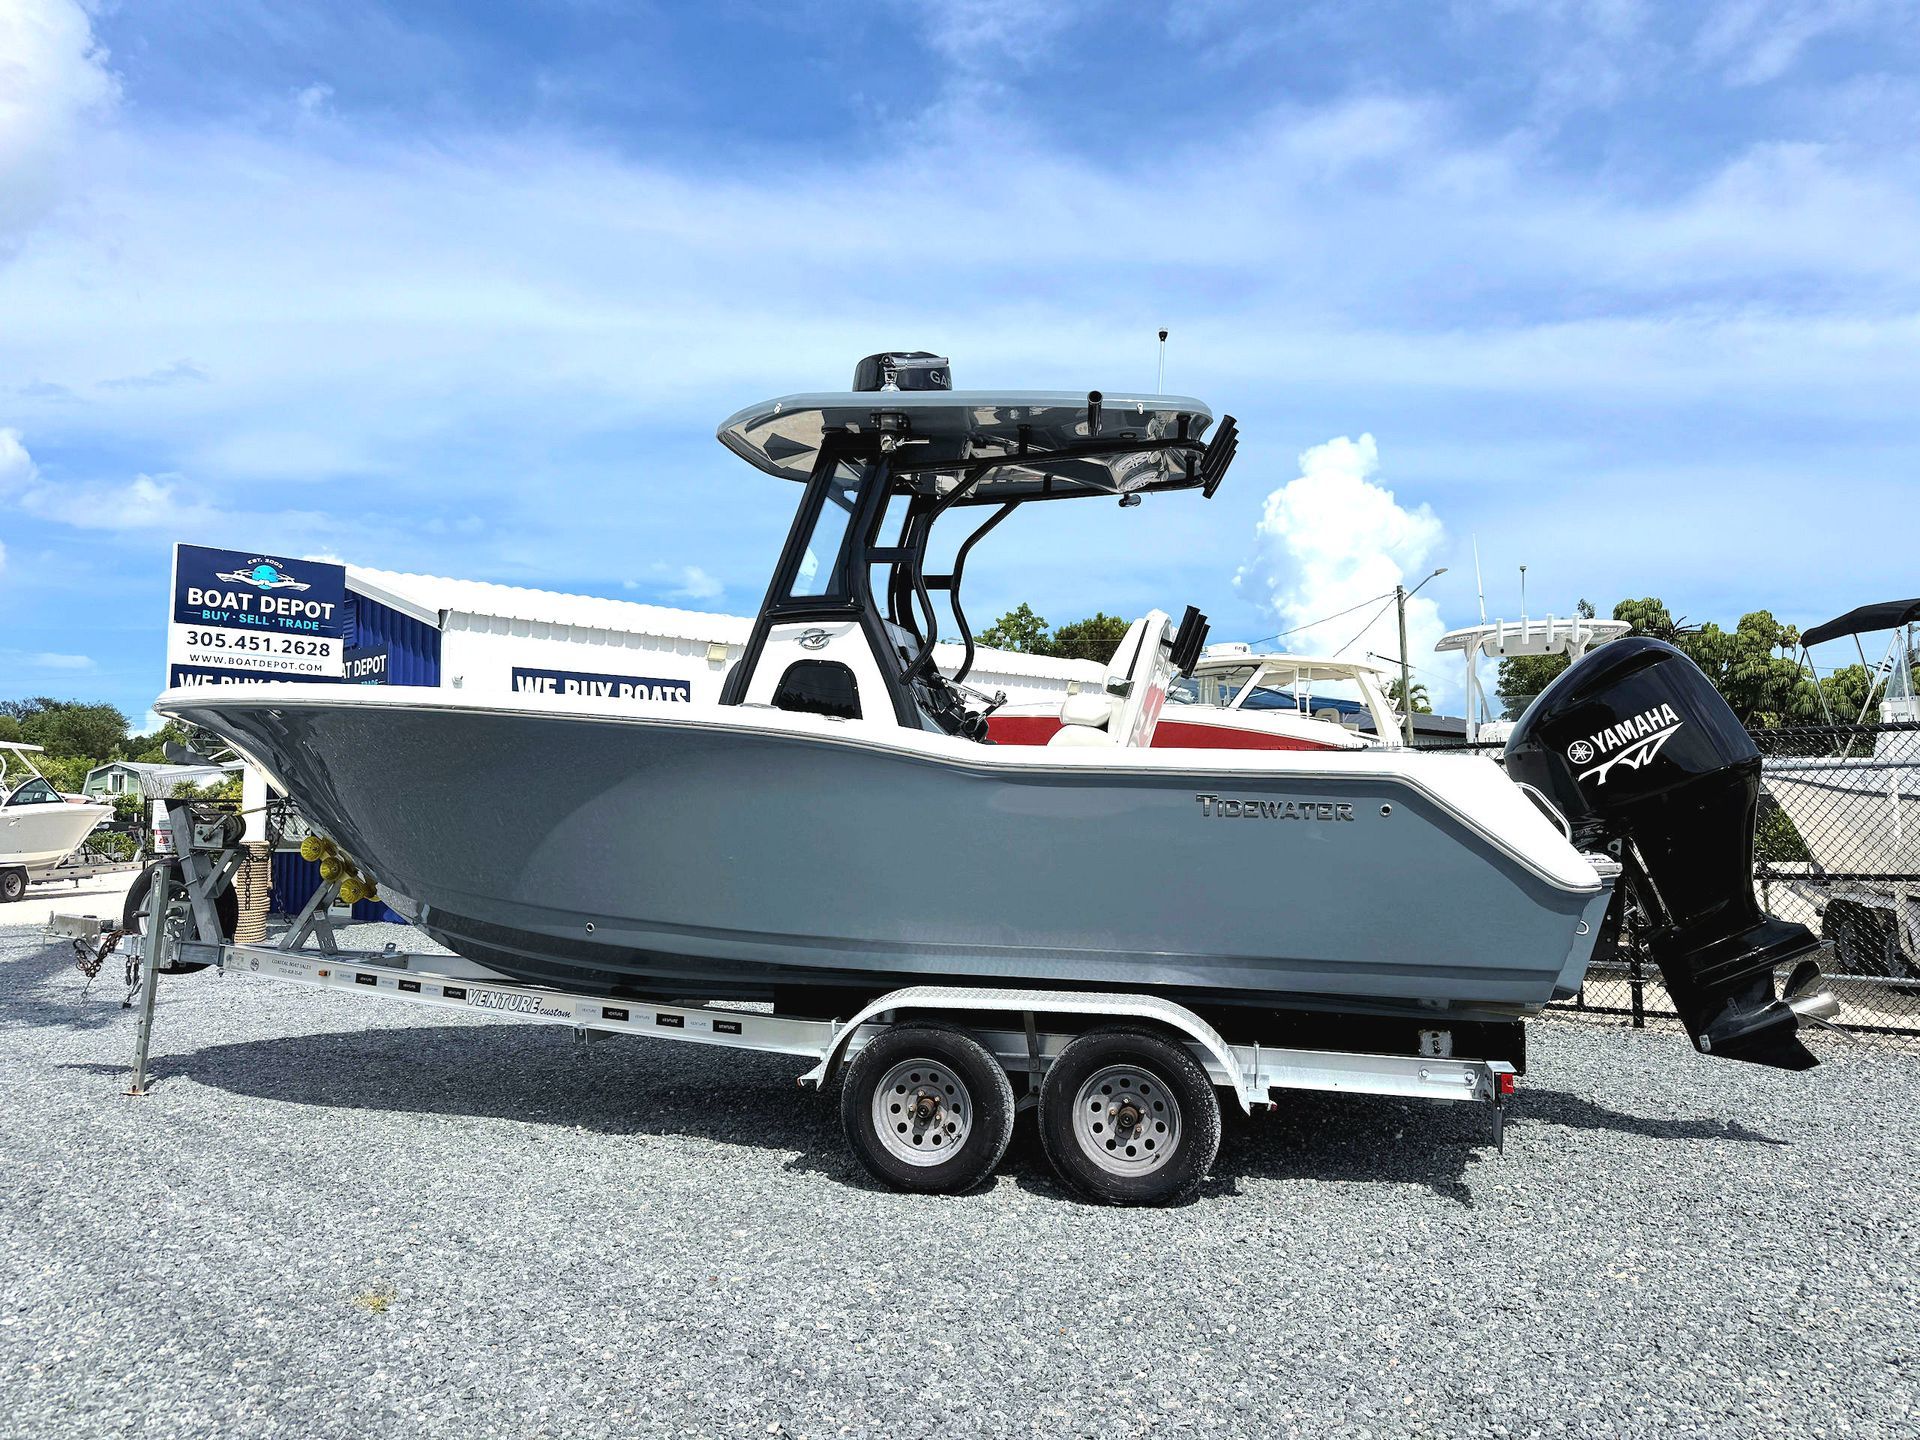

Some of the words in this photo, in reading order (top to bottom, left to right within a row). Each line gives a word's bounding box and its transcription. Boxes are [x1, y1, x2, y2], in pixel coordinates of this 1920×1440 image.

[187, 587, 254, 611] BOAT
[260, 596, 336, 620] DEPOT
[202, 609, 230, 621] BUY
[239, 613, 270, 626] SELL
[277, 617, 320, 631] TRADE
[186, 630, 331, 657] 305.451.2628
[189, 653, 323, 672] WWW.BOATDEPOT.COM
[354, 654, 387, 677] DEPOT
[516, 675, 557, 694] WE
[564, 679, 613, 698] BUY
[619, 683, 687, 702] BOATS
[1590, 702, 1680, 754] YAMAHA
[1195, 793, 1355, 822] TIDEWATER
[467, 988, 543, 1014] VENTURE
[539, 1008, 572, 1018] custom
